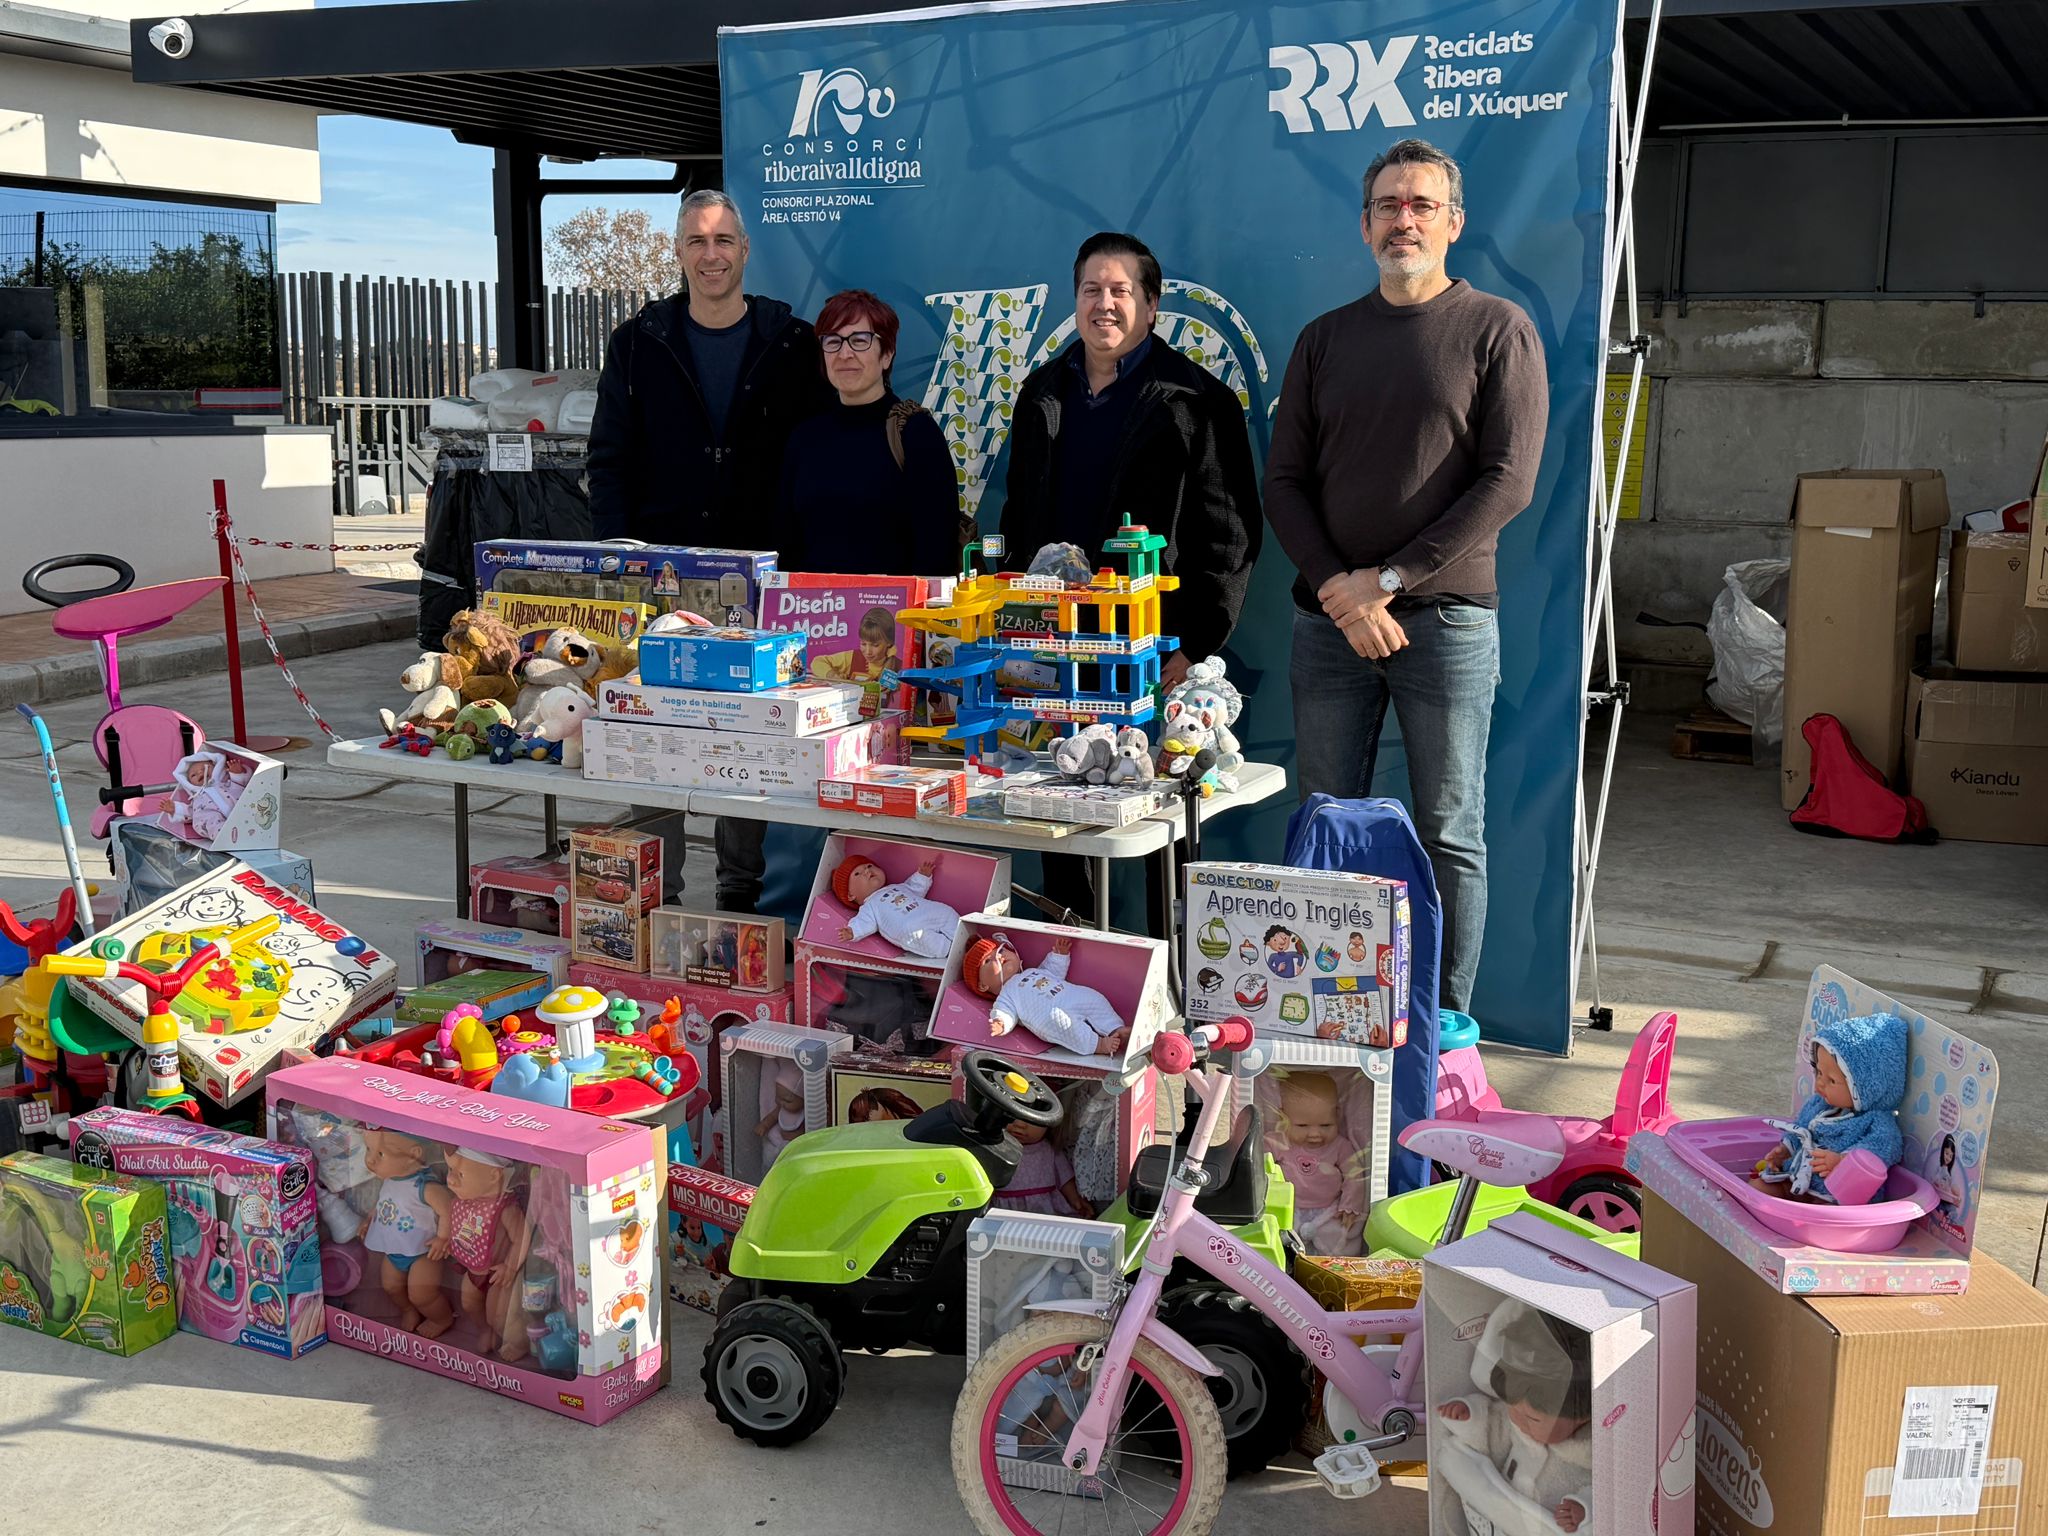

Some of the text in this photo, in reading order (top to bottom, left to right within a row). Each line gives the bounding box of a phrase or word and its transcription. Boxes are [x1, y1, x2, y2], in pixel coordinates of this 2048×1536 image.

[1424, 30, 1534, 59] Reciclats
[1423, 64, 1502, 89] Ribera
[1422, 89, 1568, 120] del Xúquer
[762, 138, 922, 156] CONSORCI
[764, 157, 922, 184] riberaivalldigna
[762, 194, 874, 208] CONSORCI PLA ZONAL
[762, 209, 841, 223] ÀREA GESTIÓ V4
[482, 550, 524, 567] Complete
[778, 590, 846, 616] Diseña
[514, 601, 557, 630] HERENCIA
[558, 606, 569, 623] DE
[728, 611, 741, 623] 69
[793, 615, 848, 639] Moda
[605, 689, 647, 709] Quien Es
[660, 696, 742, 710] Juego de habilidad
[1951, 768, 2020, 786] Kiandu
[1196, 872, 1275, 892] CONECTOR
[1206, 889, 1374, 929] Aprendo Inglés
[1190, 998, 1209, 1010] 352
[1372, 1064, 1383, 1072] 3+
[1979, 1062, 1991, 1072] 3+
[363, 1075, 552, 1132] Baby Jill & Baby Yara
[77, 1140, 101, 1156] Crazy
[80, 1154, 110, 1168] CHIC
[120, 1154, 210, 1170] Nail Art Studio
[284, 1173, 306, 1192] CHIC
[613, 1194, 635, 1209] ROCKS
[672, 1184, 748, 1222] MIS MOLDE
[1940, 1216, 1966, 1241] Jesmar
[1091, 1256, 1101, 1264] 2+
[1788, 1275, 1820, 1287] Bubble
[1931, 1280, 1961, 1290] Jesmar
[1237, 1262, 1310, 1331] HELLO KITTY
[249, 1335, 286, 1351] Clementoni
[334, 1313, 524, 1393] Baby Jill & Baby Yara
[602, 1372, 629, 1391] Baby
[649, 1355, 657, 1369] &
[560, 1394, 583, 1406] ROCKS
[604, 1389, 630, 1407] Baby
[1701, 1419, 1759, 1509] lorens
